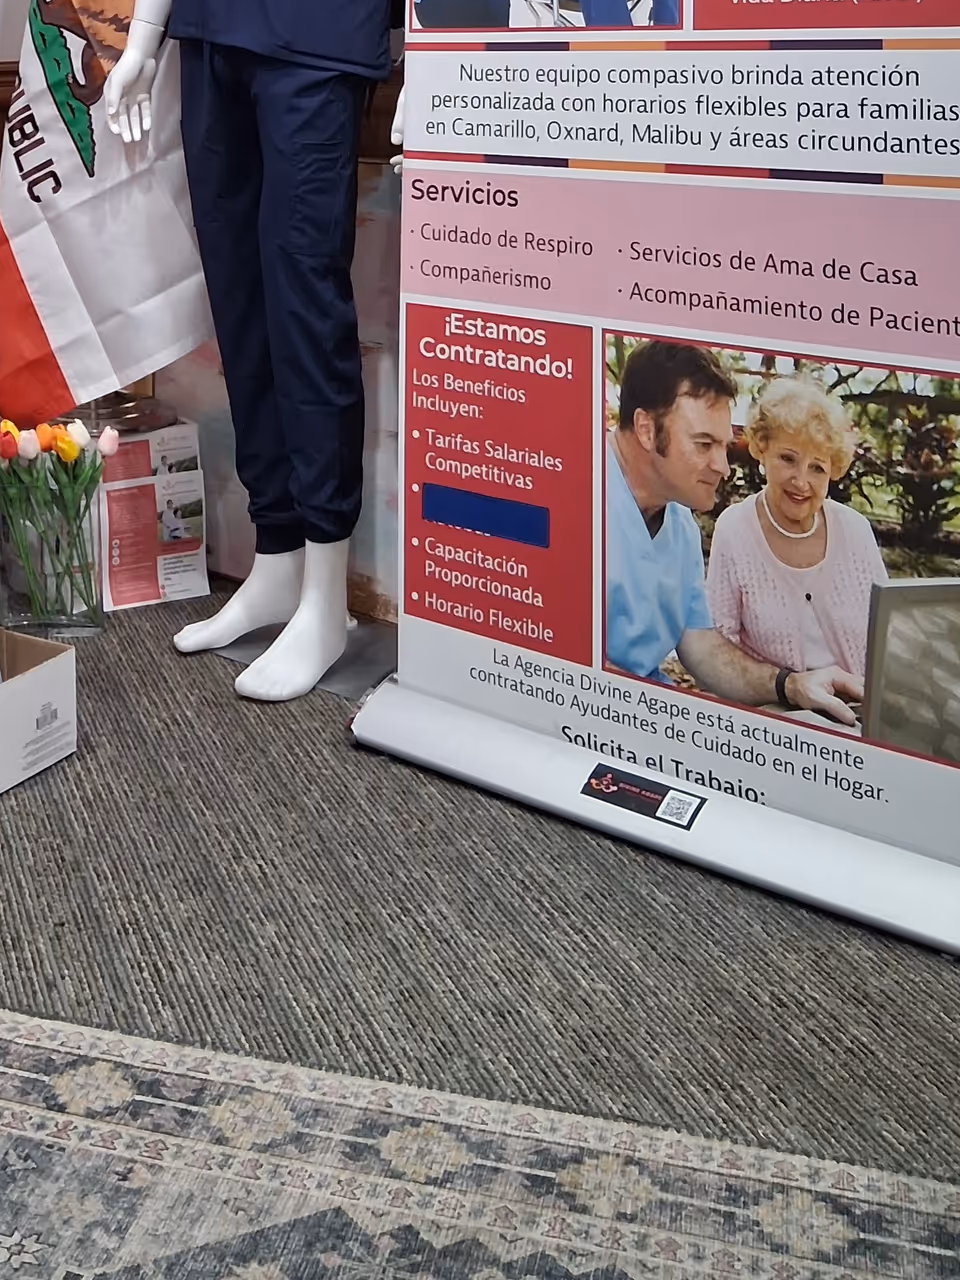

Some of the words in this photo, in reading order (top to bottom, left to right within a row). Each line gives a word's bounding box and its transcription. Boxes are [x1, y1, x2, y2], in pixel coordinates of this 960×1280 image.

[461, 64, 529, 82] Nuestro
[536, 64, 600, 87] equipo
[608, 65, 723, 88] compasivo
[732, 64, 803, 85] brinda
[812, 65, 919, 86] atención
[432, 92, 555, 111] personalizada
[562, 98, 594, 112] con
[604, 93, 686, 114] horarios
[695, 95, 786, 116] flexibles
[798, 103, 850, 122] para
[858, 98, 959, 121] familias
[426, 122, 445, 134] en
[453, 118, 539, 142] Camarillo,
[548, 121, 623, 145] Oxnard,
[633, 124, 701, 145] Malibu
[710, 132, 721, 150] y
[730, 127, 788, 148] áreas
[799, 129, 960, 155] circundantes
[412, 179, 518, 207] Servicios
[421, 223, 491, 245] Cuidado
[498, 230, 517, 248] de
[525, 233, 592, 257] Respiro
[421, 260, 550, 290] Compañerismo
[630, 242, 721, 267] Servicios
[730, 251, 755, 271] de
[764, 254, 814, 276] Ama
[823, 258, 850, 280] de
[861, 262, 918, 286] Casa
[630, 282, 822, 321] Acompañamiento
[832, 303, 859, 325] de
[446, 313, 546, 345] ¡Estamos
[420, 337, 572, 379] Contratando!
[413, 391, 483, 418] Incluyen:
[414, 369, 438, 387] Los
[444, 373, 525, 402] Beneficios
[426, 429, 479, 454] Tarifas
[485, 440, 562, 471] Salariales
[426, 449, 532, 489] Competitivas
[425, 538, 527, 581] Capacitación
[426, 560, 543, 608] Proporcionada
[426, 592, 483, 622] Horario
[490, 609, 553, 642] Flexible
[494, 648, 509, 667] La
[514, 655, 574, 686] Agencia
[581, 674, 631, 703] Divine
[637, 691, 690, 720] Agape
[697, 712, 735, 734] está
[741, 725, 863, 770] actualmente
[470, 665, 564, 706] contratando
[570, 695, 658, 734] Ayudantes
[665, 723, 685, 743] de
[692, 727, 769, 766] Cuidado
[773, 758, 794, 775] en
[802, 765, 816, 782] el
[825, 768, 888, 802] Hogar.
[562, 726, 637, 764] Solicita
[646, 755, 663, 772] el
